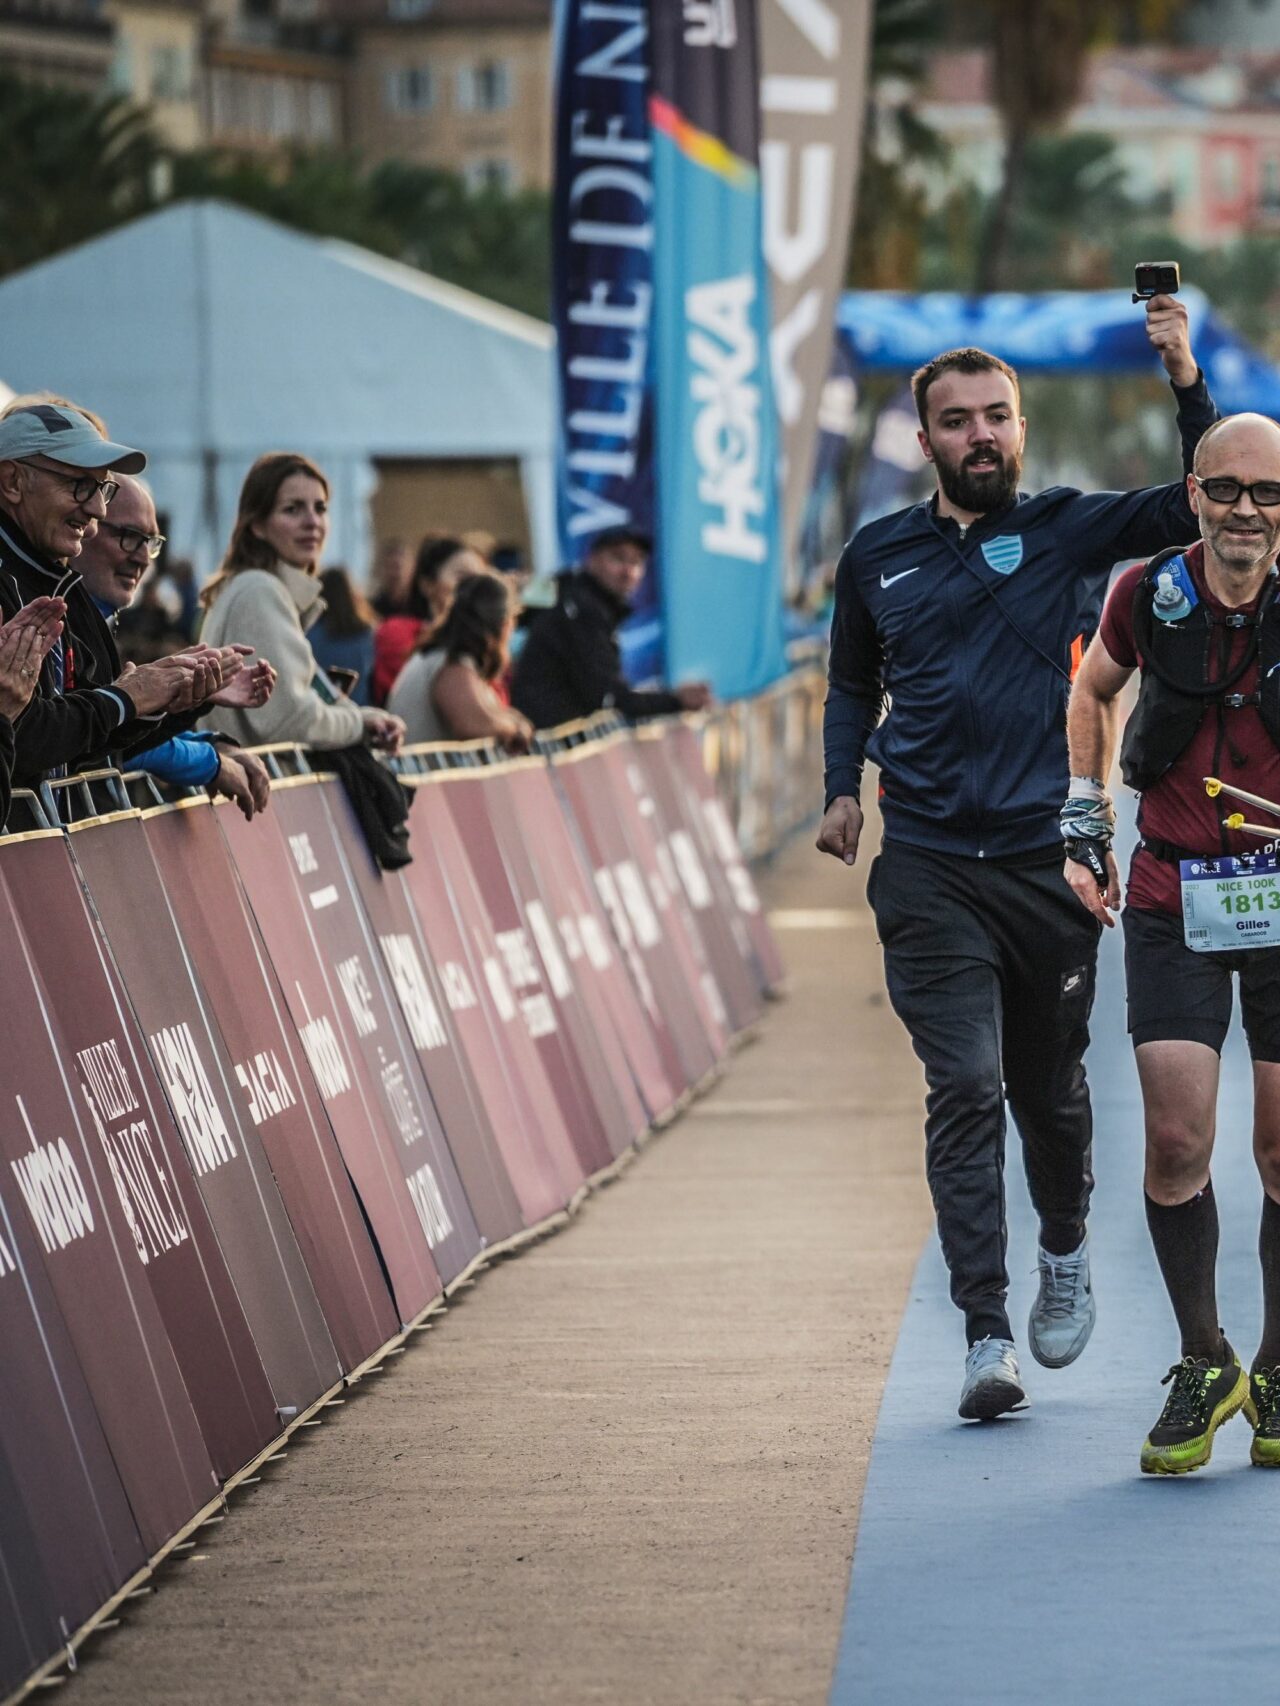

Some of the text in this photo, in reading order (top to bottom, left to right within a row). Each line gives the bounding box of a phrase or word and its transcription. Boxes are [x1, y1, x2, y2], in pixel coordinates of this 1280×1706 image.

[569, 108, 655, 247] DE
[566, 278, 655, 537] VILLE
[684, 275, 769, 564] HOKA
[1216, 878, 1276, 893] NICE 100K
[1236, 920, 1270, 931] Gilles
[76, 1038, 140, 1123] VILLE DE
[151, 1021, 238, 1177] HOKA
[234, 1049, 297, 1126] DACIA
[294, 979, 351, 1101] wahoo
[10, 1094, 95, 1254] wahoo
[109, 1118, 189, 1259] NICE
